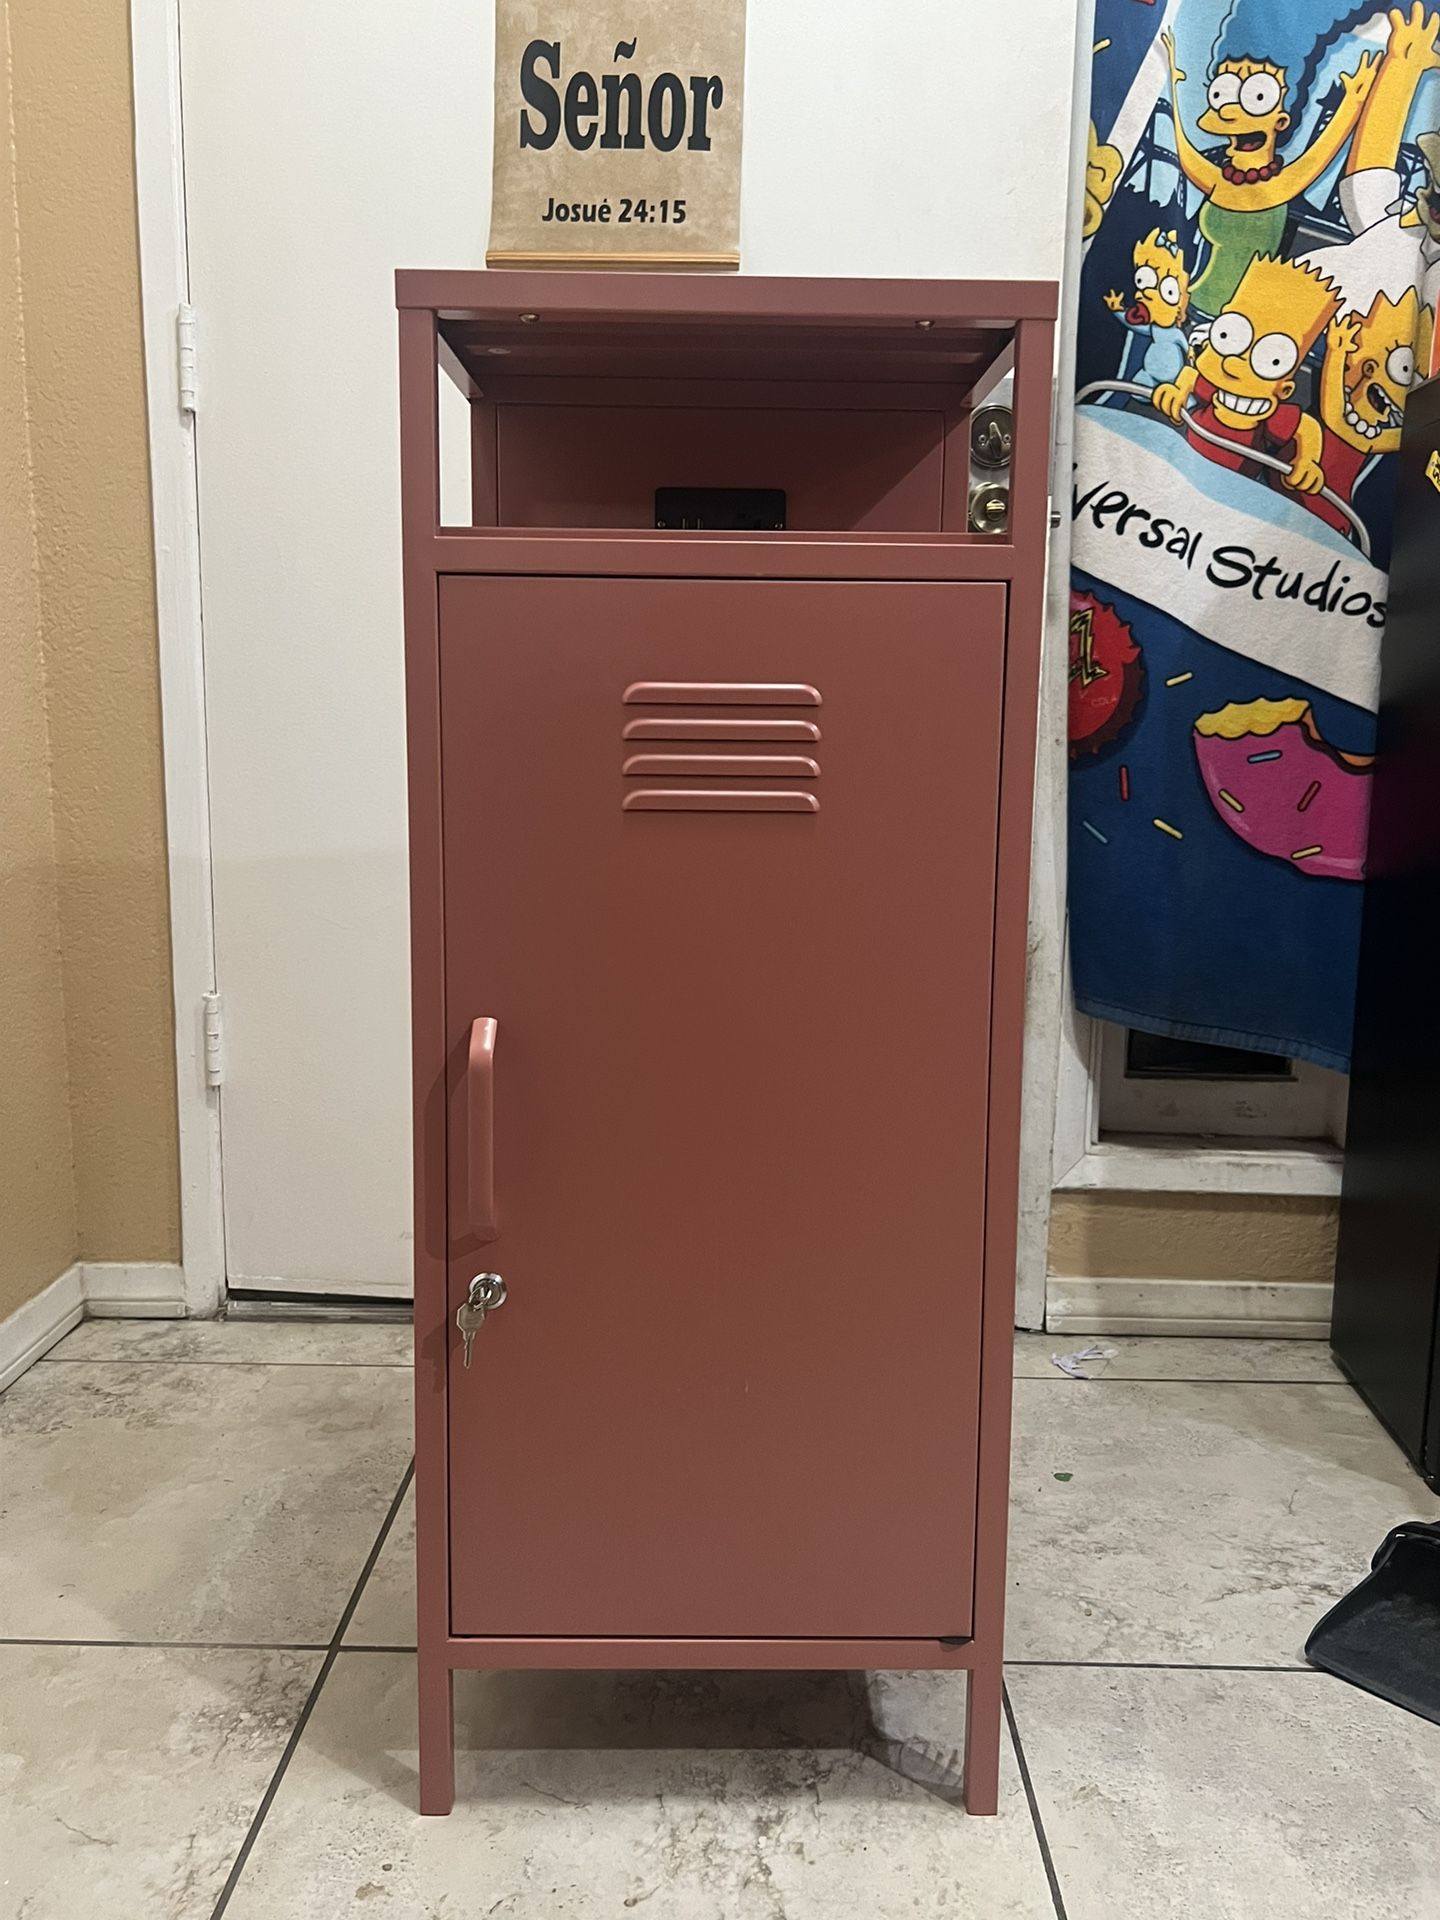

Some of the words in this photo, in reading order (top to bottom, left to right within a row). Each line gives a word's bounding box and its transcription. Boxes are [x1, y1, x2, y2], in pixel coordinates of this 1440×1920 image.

[519, 36, 723, 152] Señor
[541, 197, 612, 223] Josué
[617, 198, 687, 224] 24:15
[1072, 464, 1202, 570] versal
[1205, 545, 1387, 628] Studios
